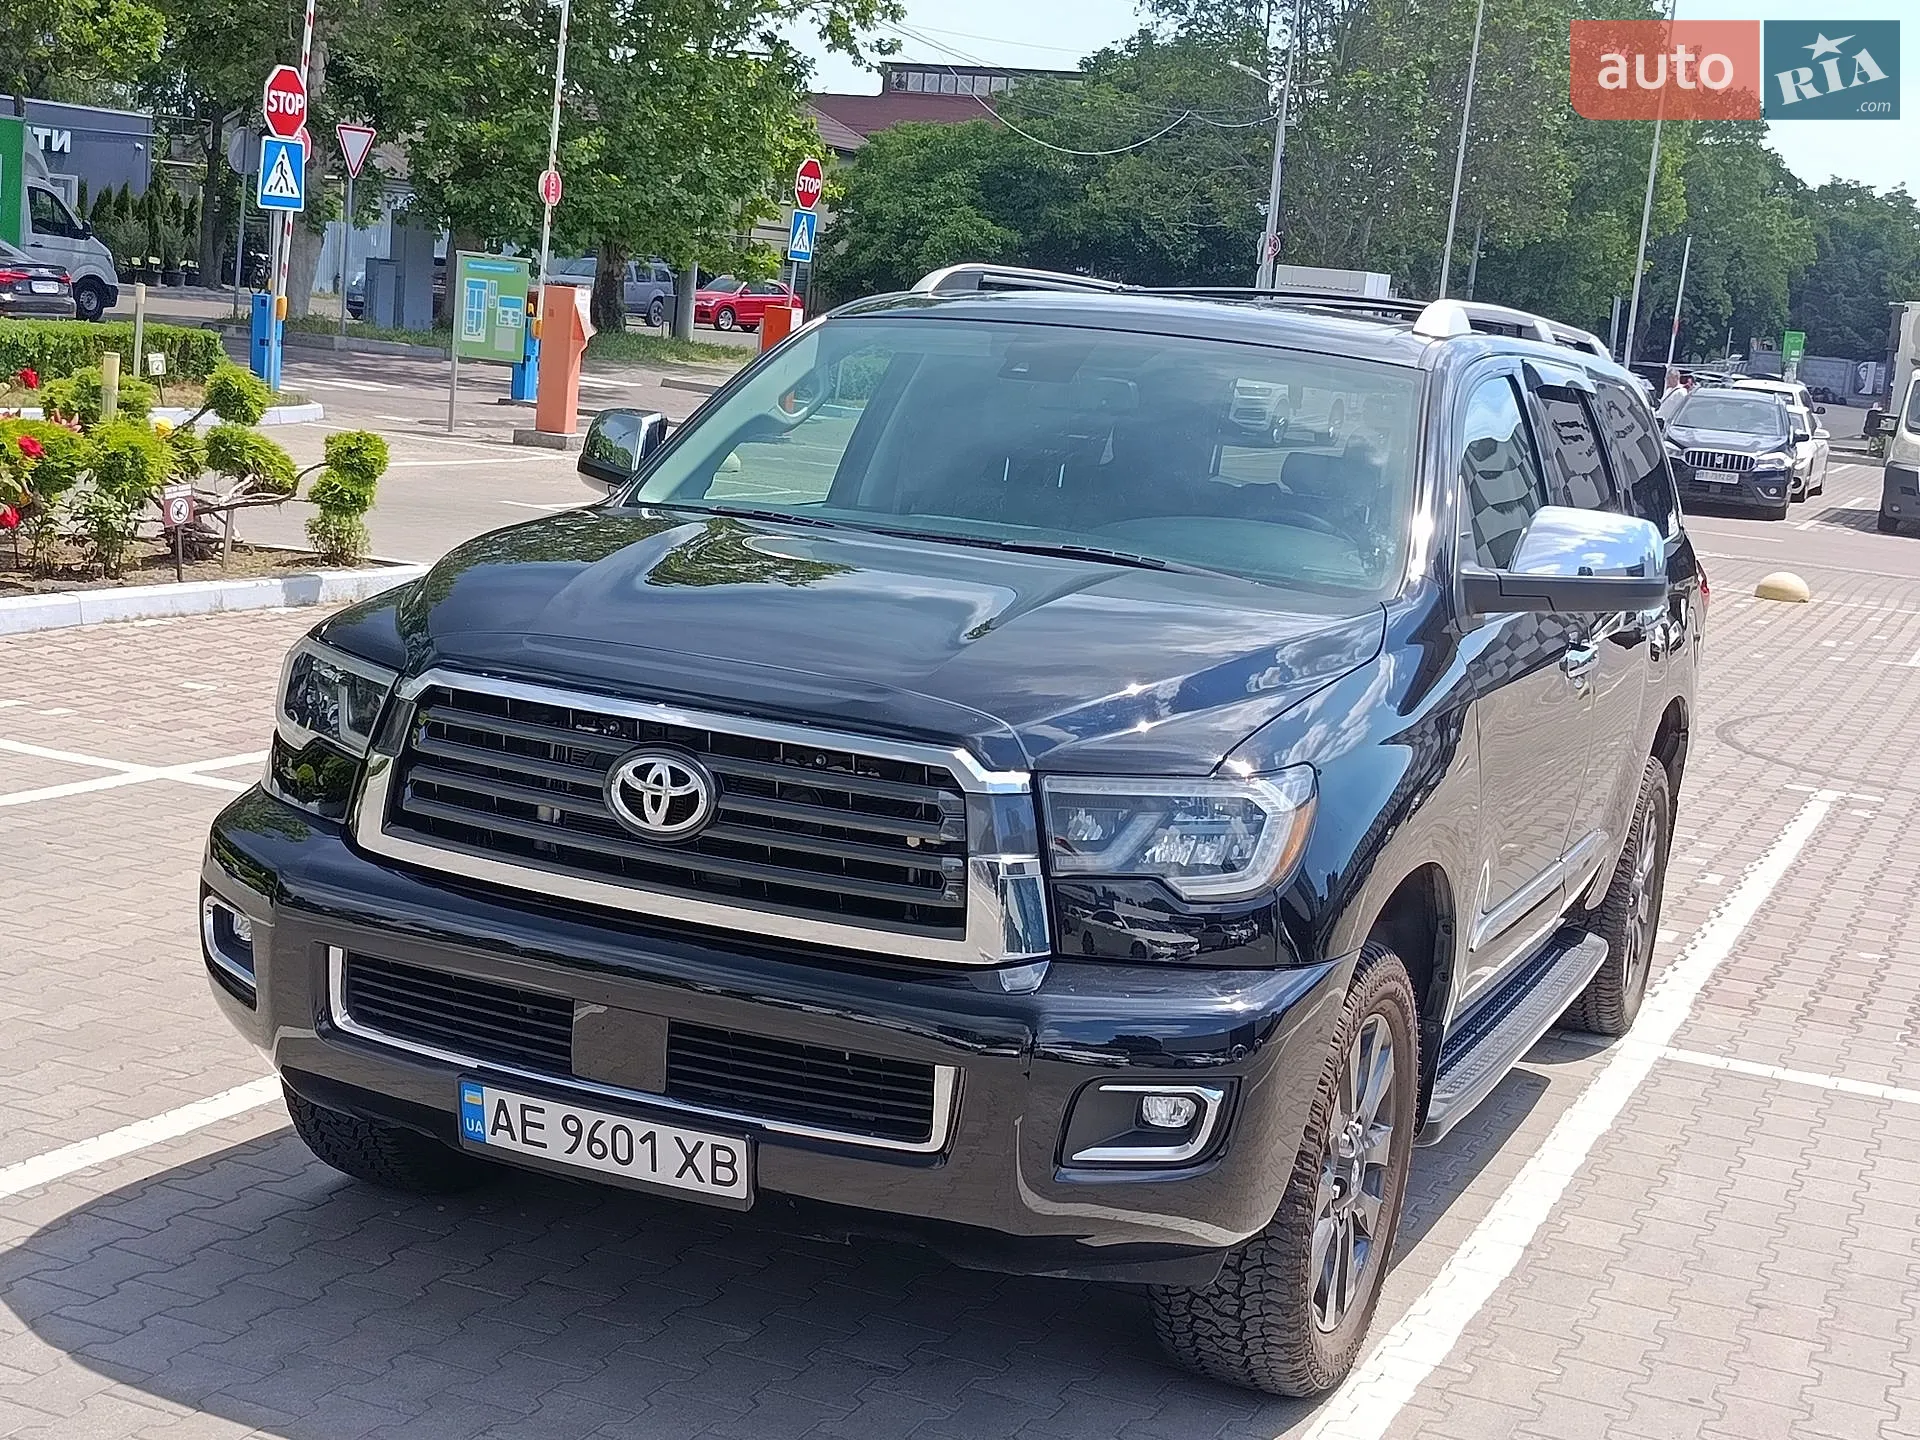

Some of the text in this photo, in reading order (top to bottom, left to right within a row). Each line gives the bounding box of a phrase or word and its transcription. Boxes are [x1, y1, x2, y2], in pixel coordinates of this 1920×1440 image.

[267, 89, 304, 116] STOP
[27, 125, 72, 153] ТИ
[797, 175, 821, 194] STOP
[465, 1119, 484, 1134] UA
[490, 1098, 739, 1188] AE 9601 XB
